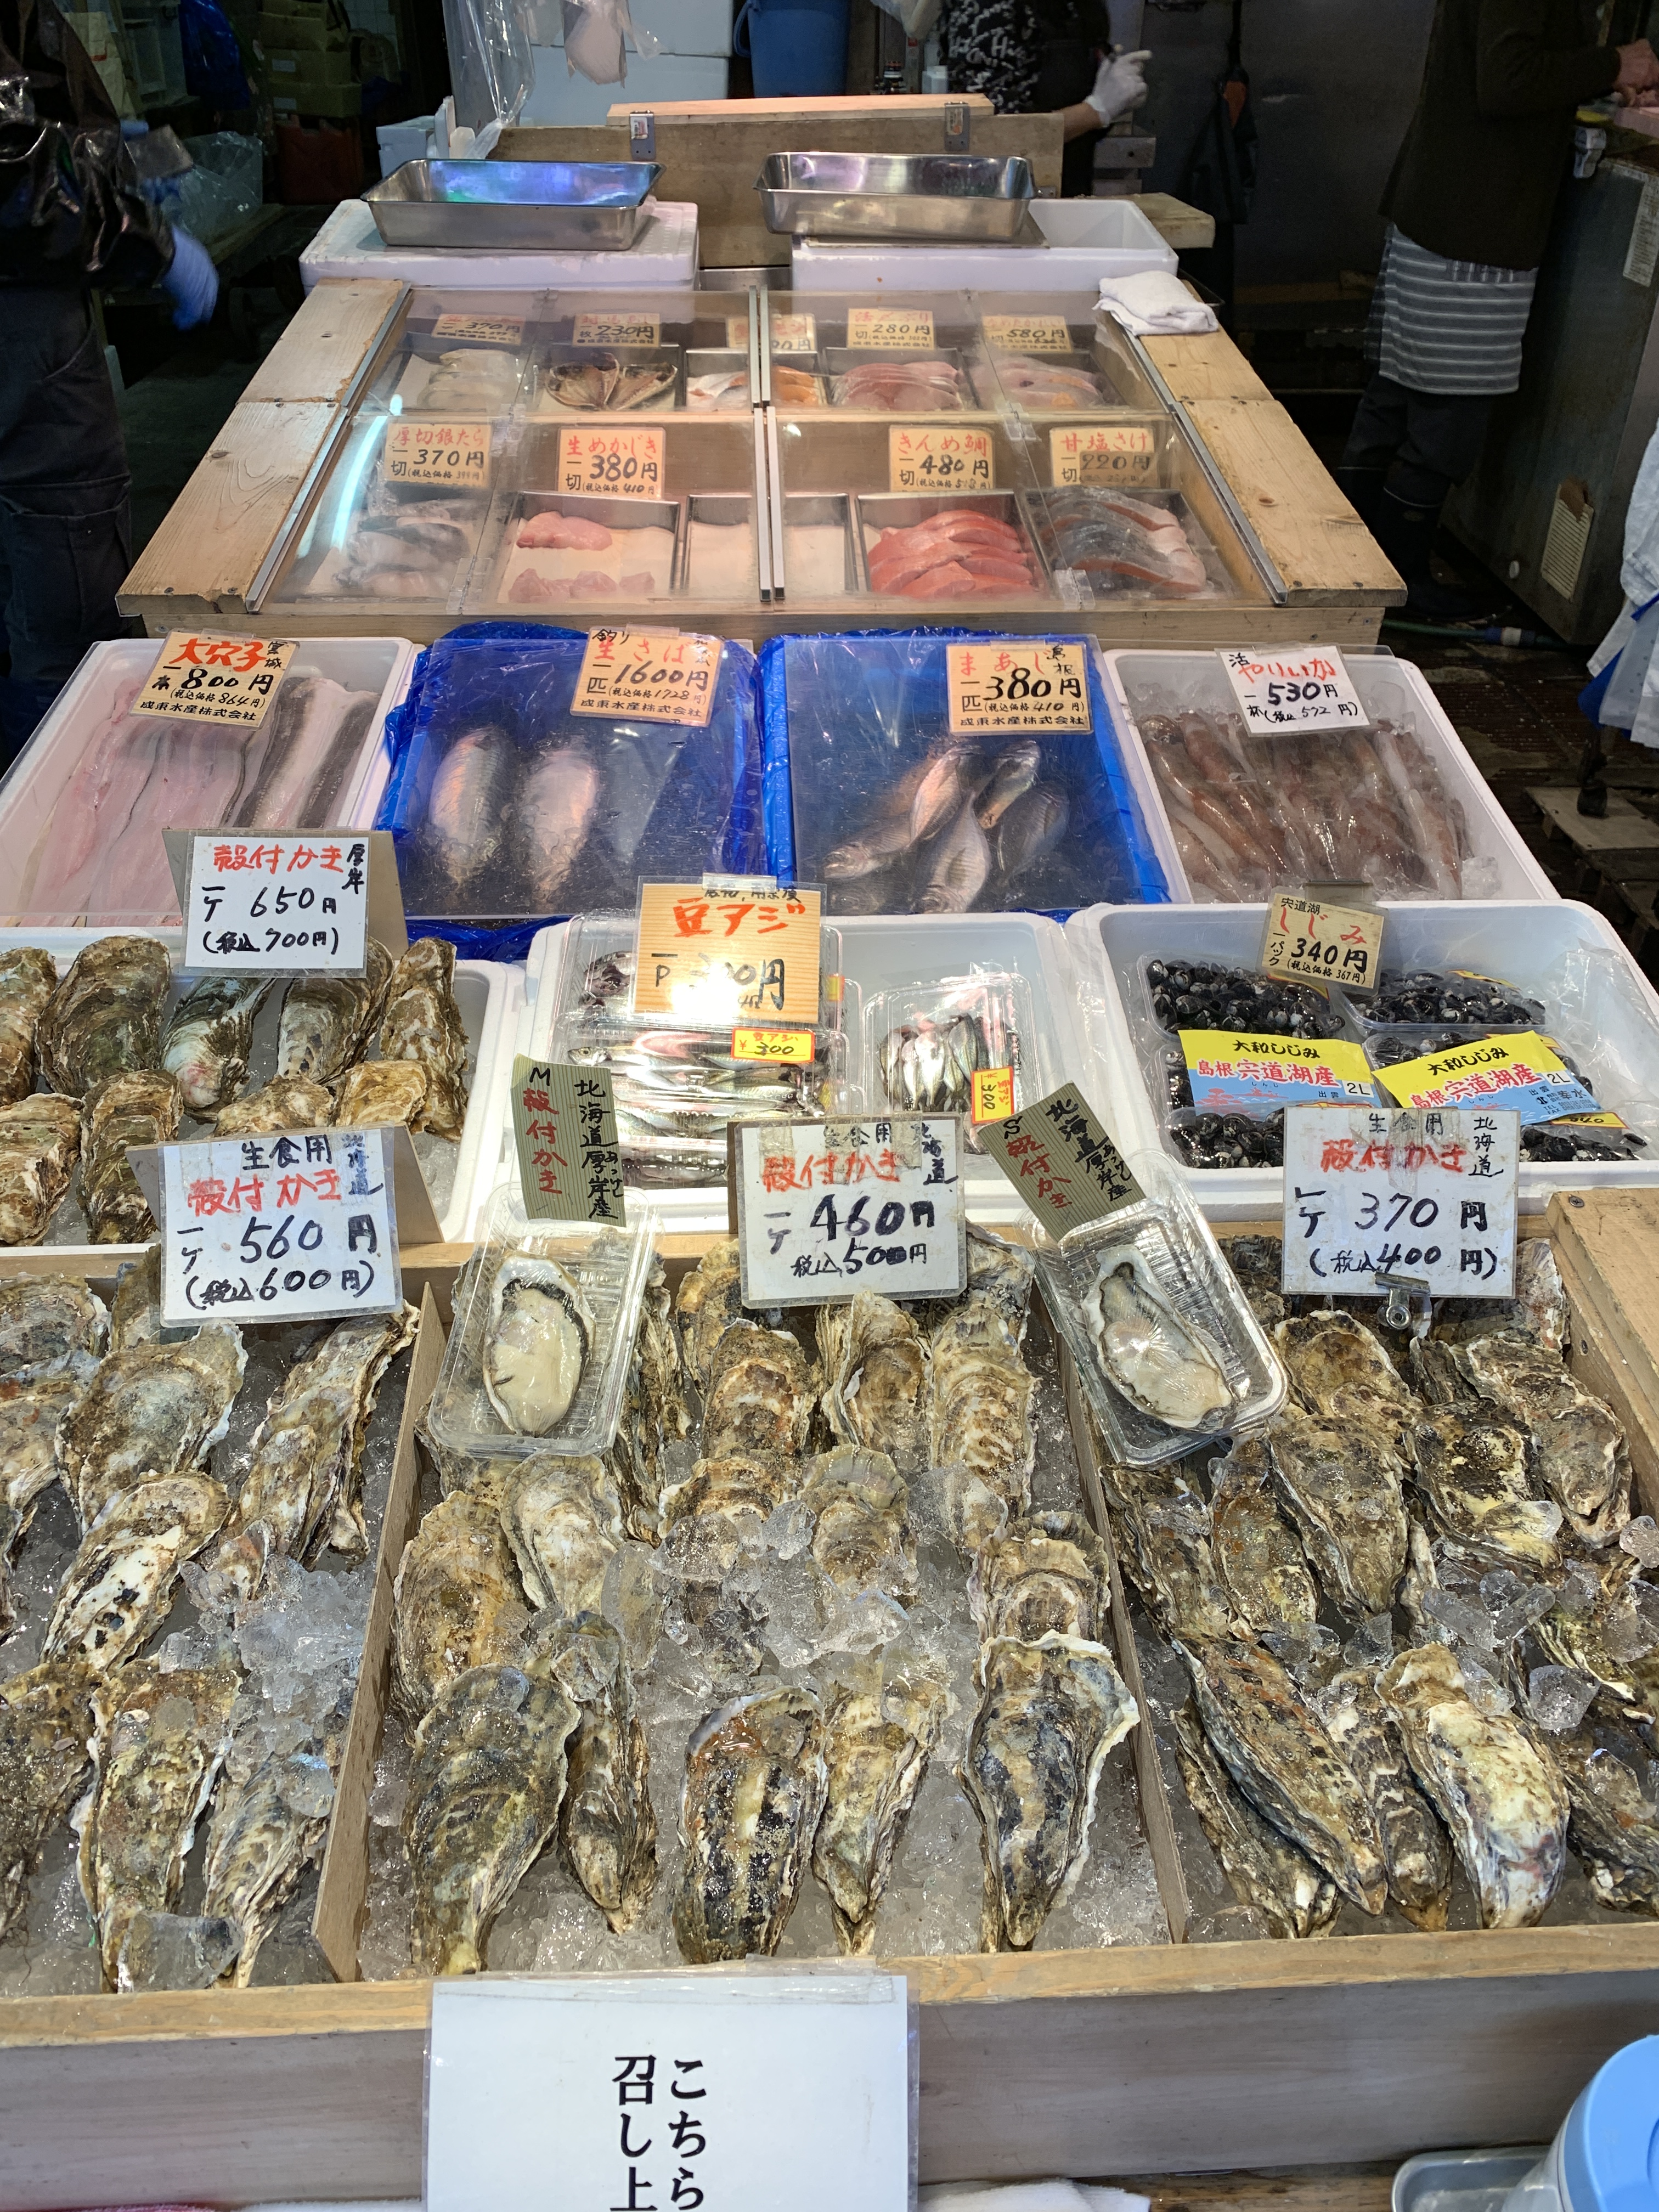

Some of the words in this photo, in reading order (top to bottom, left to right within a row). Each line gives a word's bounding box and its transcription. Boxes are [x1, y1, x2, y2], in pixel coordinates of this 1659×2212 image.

[465, 322, 521, 334] 370円
[595, 325, 654, 339] 230円
[872, 324, 930, 335] 280円
[1006, 329, 1065, 338] 580円
[393, 426, 484, 447] 厚切銀たら
[567, 435, 657, 460] 生めかじき
[898, 432, 986, 457] きんめ鯛
[1060, 431, 1148, 453] 甘塩さけ
[391, 449, 408, 476] 一切
[413, 449, 484, 469] 370円
[589, 453, 658, 482] 380円
[899, 458, 915, 486] 一切
[919, 454, 989, 479] 480円
[1061, 456, 1077, 482] 一切
[566, 461, 582, 490] 一切
[591, 628, 630, 646] 釣り
[594, 637, 690, 664] 生さば
[168, 637, 267, 672] 大穴子
[959, 651, 1051, 676] まあじ
[1228, 652, 1250, 668] 活
[180, 668, 274, 696] 800円
[586, 663, 612, 694] 一匹
[614, 660, 709, 692] 1600円
[982, 667, 1082, 701] 380円
[1238, 658, 1336, 684] やりいか
[960, 681, 983, 713] 一匹
[1267, 682, 1339, 706] 530円
[140, 701, 257, 721] 成東水産株式会社
[580, 699, 702, 718] 成東水産株式会社
[960, 716, 1085, 726] 成東水産株式会社
[213, 844, 345, 875] 殻付かき
[341, 843, 366, 895] 厚岸
[250, 885, 336, 918] 650円
[1280, 897, 1321, 915] 宍道湖
[673, 896, 806, 938] 豆アジ
[1279, 907, 1368, 945] しじみ
[1268, 932, 1286, 966] 一パック
[1291, 938, 1368, 973] 340円
[1232, 1040, 1321, 1059] 大和しじみ
[1427, 1047, 1509, 1075] 大和しじみ
[529, 1067, 551, 1086] M
[1198, 1059, 1341, 1088] 島根宍道湖産
[1547, 1073, 1571, 1084] 2L
[1346, 1082, 1370, 1096] 2L
[1528, 1086, 1550, 1096] 出雲
[1003, 1115, 1023, 1139] S
[1368, 1111, 1444, 1135] 生食用
[241, 1133, 333, 1170] 生食用
[522, 1087, 568, 1194] 殻付かき
[574, 1079, 619, 1220] 北海道厚岸産
[1045, 1098, 1132, 1201] 北海道厚岸産
[1468, 1115, 1504, 1178] 北海道
[1320, 1138, 1468, 1173] 殻付かき
[603, 1151, 624, 1198] あっけし
[761, 1148, 900, 1193] 殻付かき
[1005, 1134, 1073, 1209] 殻付かき
[187, 1168, 342, 1217] 殻付かき
[809, 1193, 935, 1241] 460円
[1354, 1192, 1488, 1233] 370円
[239, 1214, 378, 1263] 560円
[610, 2054, 658, 2211] 召し上
[668, 2059, 707, 2211] こちら
